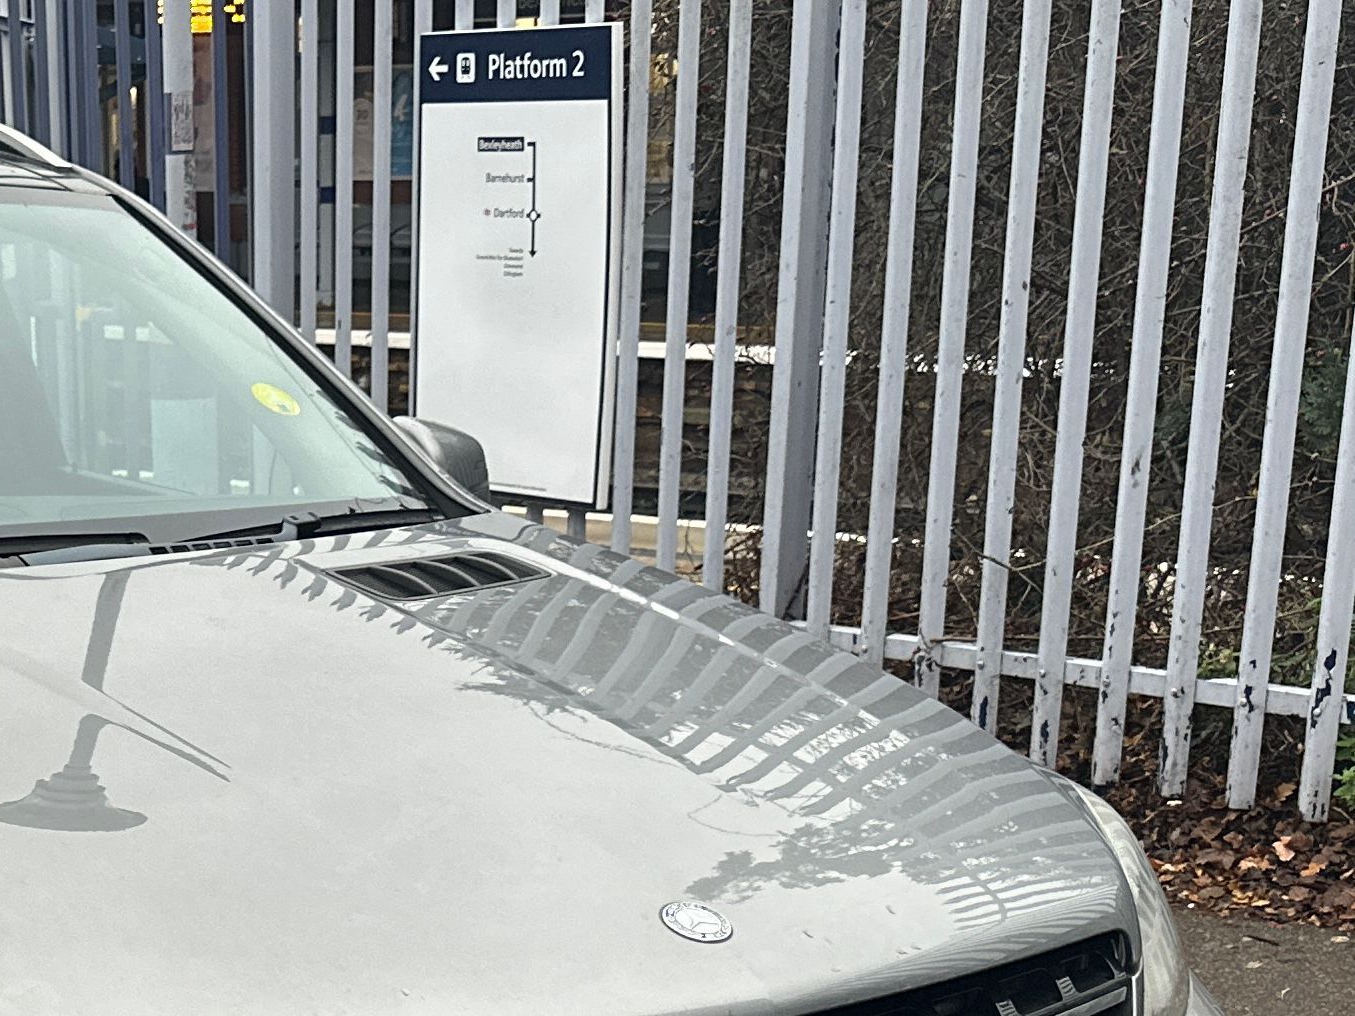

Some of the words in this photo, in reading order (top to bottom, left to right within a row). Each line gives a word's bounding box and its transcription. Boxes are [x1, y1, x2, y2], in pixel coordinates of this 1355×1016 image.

[488, 52, 568, 80] Platform
[572, 49, 585, 77] 2
[493, 207, 525, 219] Dartford
